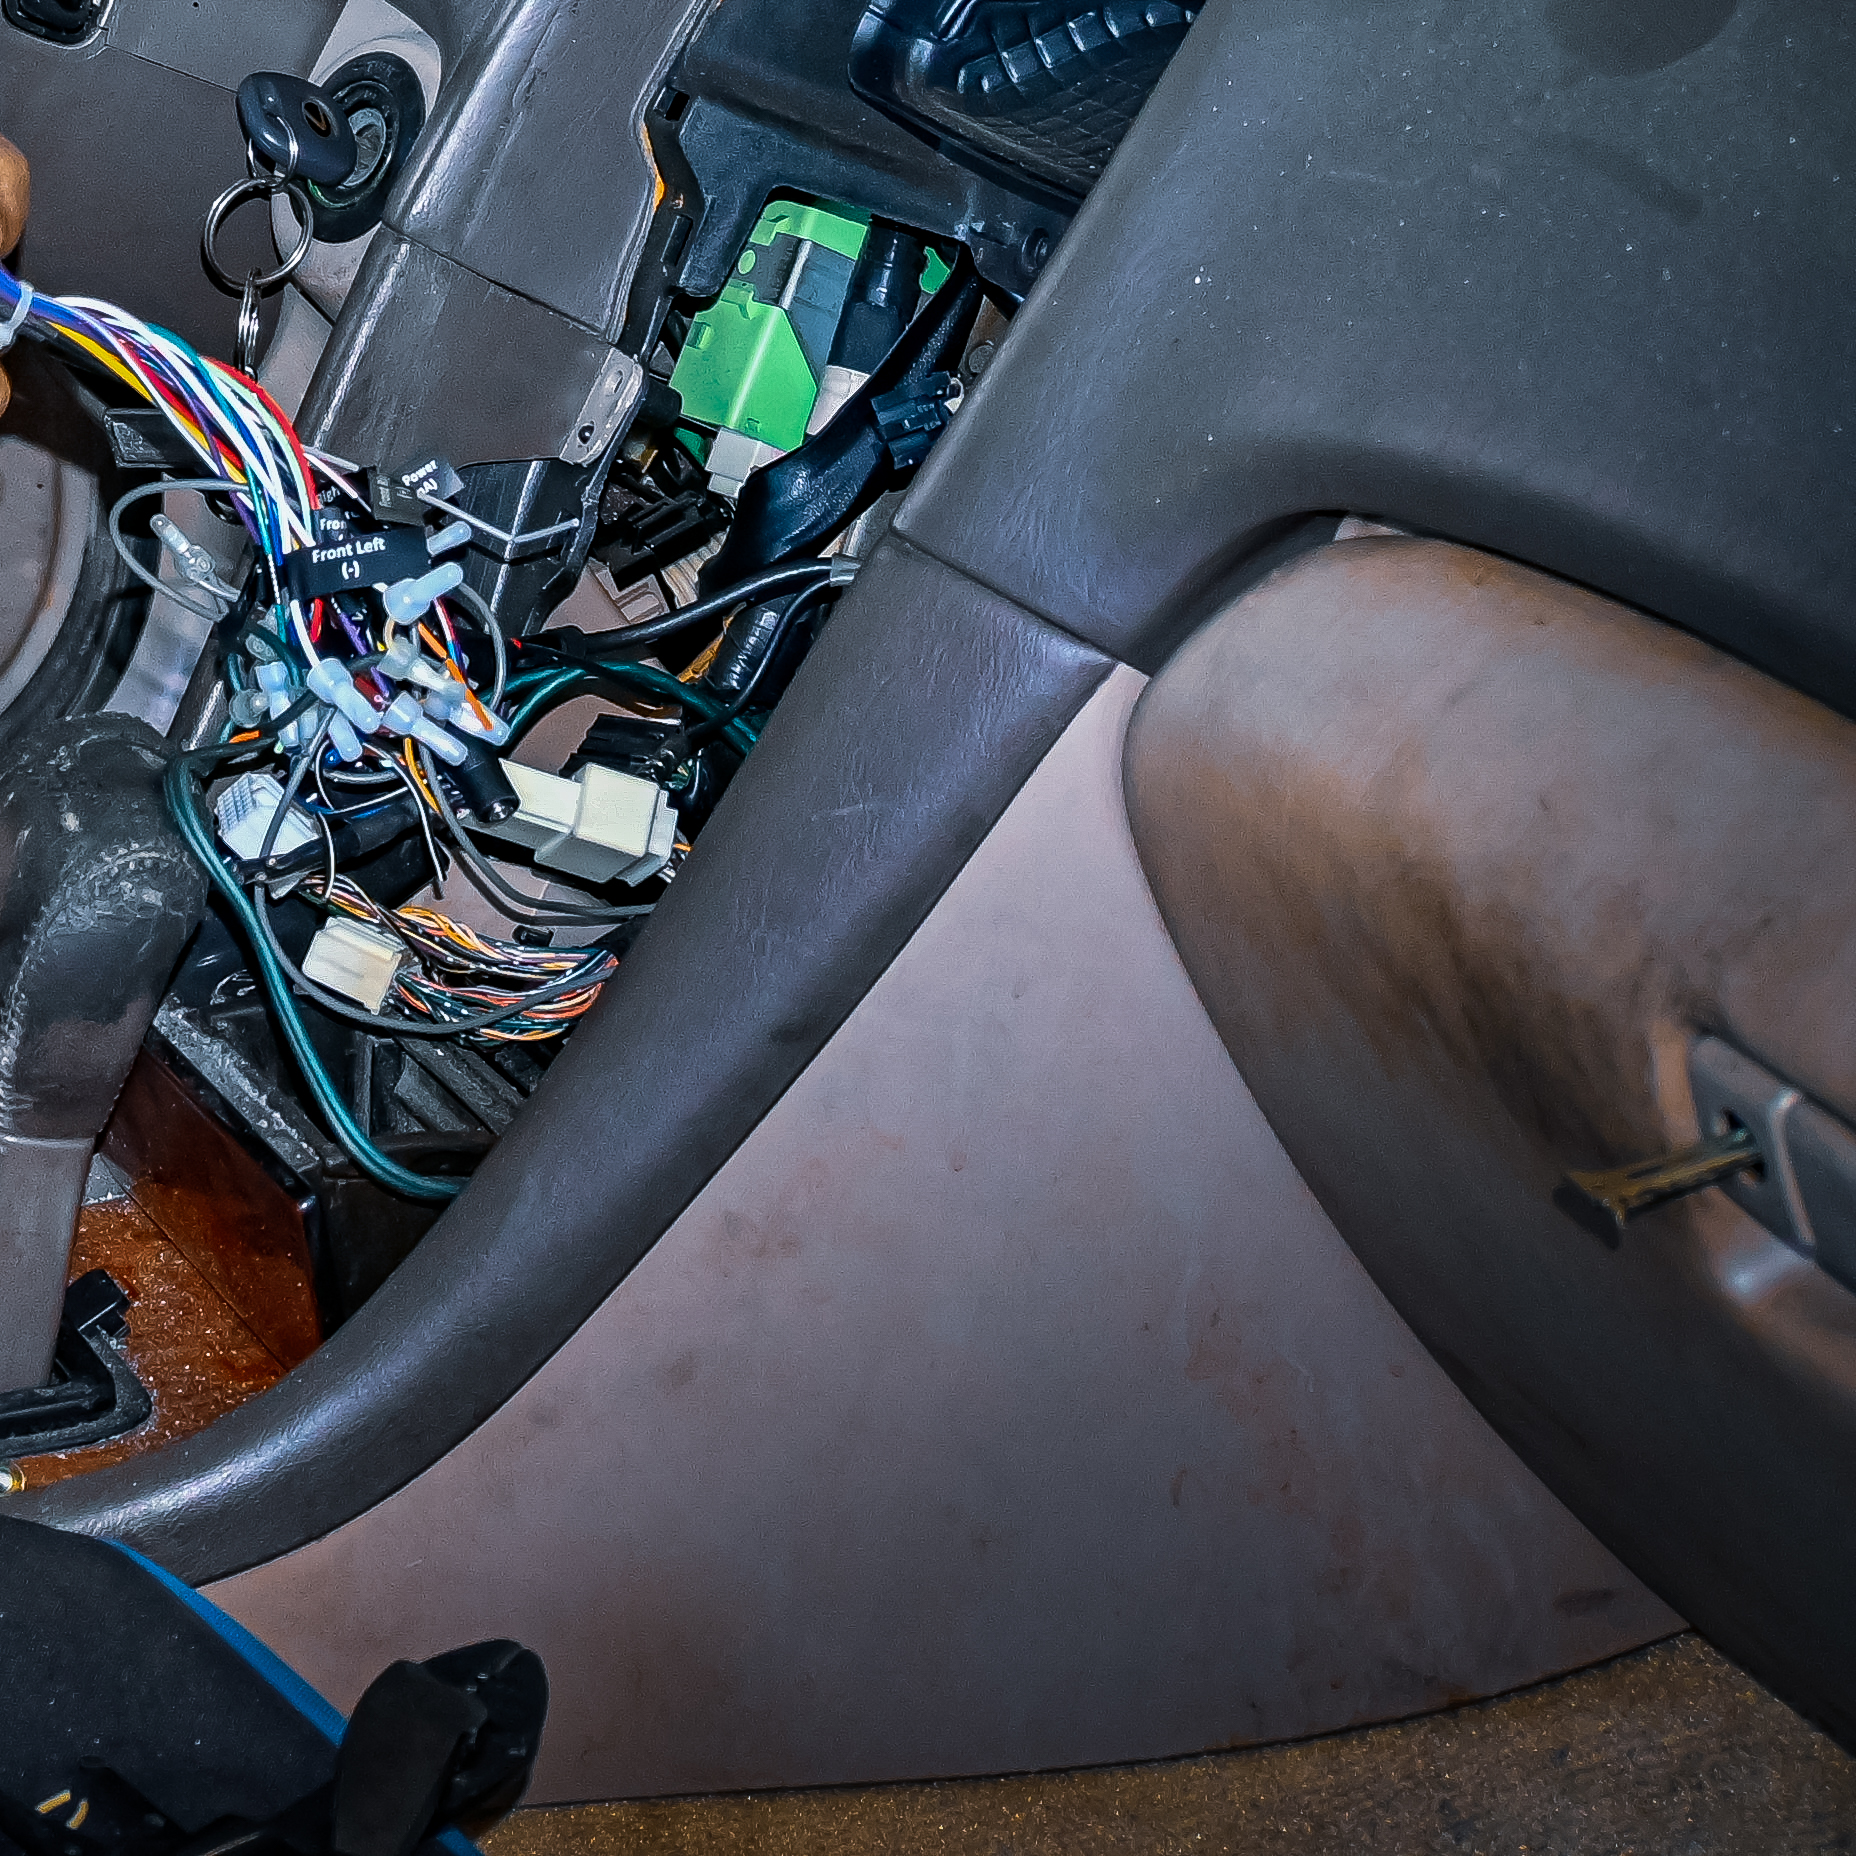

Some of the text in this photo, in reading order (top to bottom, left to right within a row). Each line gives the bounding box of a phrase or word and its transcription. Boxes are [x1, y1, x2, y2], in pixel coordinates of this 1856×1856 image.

[402, 460, 438, 486] Power
[312, 536, 387, 564] Front Left
